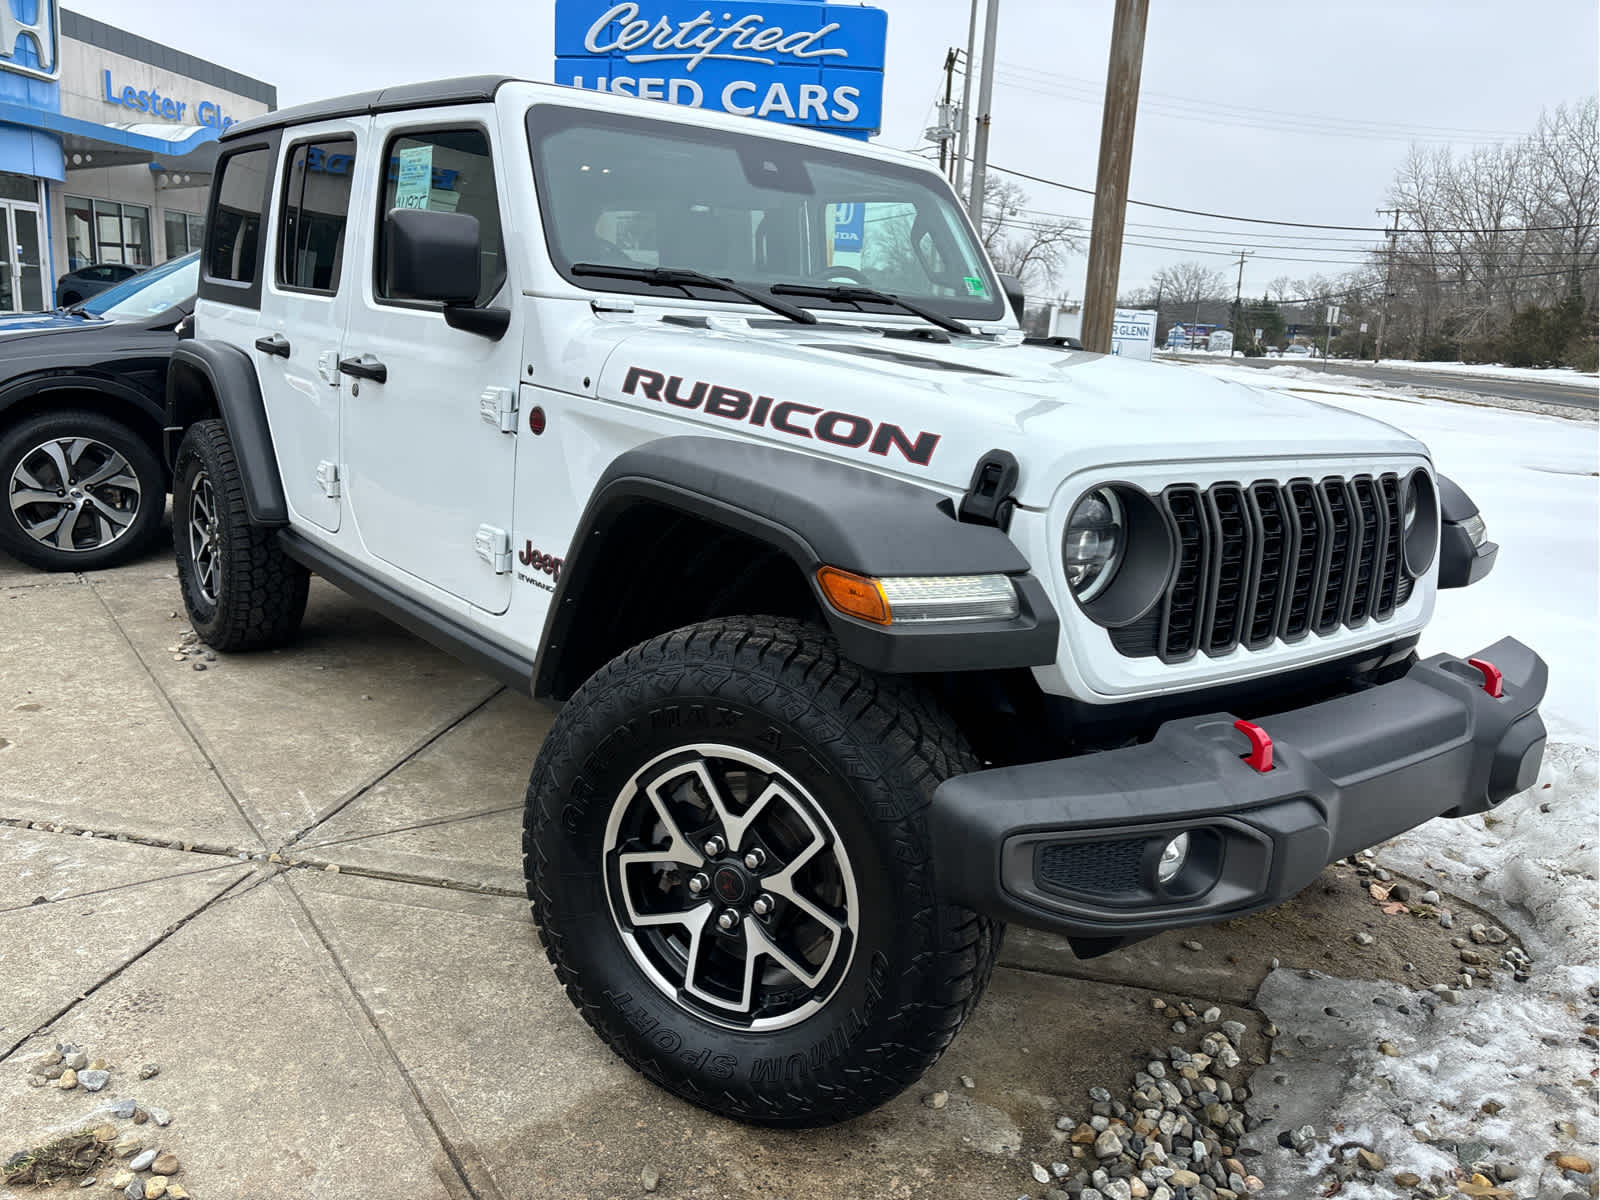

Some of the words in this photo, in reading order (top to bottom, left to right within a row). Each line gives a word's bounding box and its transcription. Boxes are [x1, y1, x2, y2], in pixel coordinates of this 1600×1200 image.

[584, 2, 848, 72] Certified
[105, 69, 187, 121] Lester
[198, 101, 238, 129] Gle
[721, 80, 860, 122] CARS
[835, 231, 860, 241] NDA
[1119, 325, 1150, 337] GLENN
[621, 366, 941, 467] RUBICON
[518, 538, 565, 583] Jeep
[525, 576, 556, 593] WRANG
[601, 986, 739, 1082] SPORT
